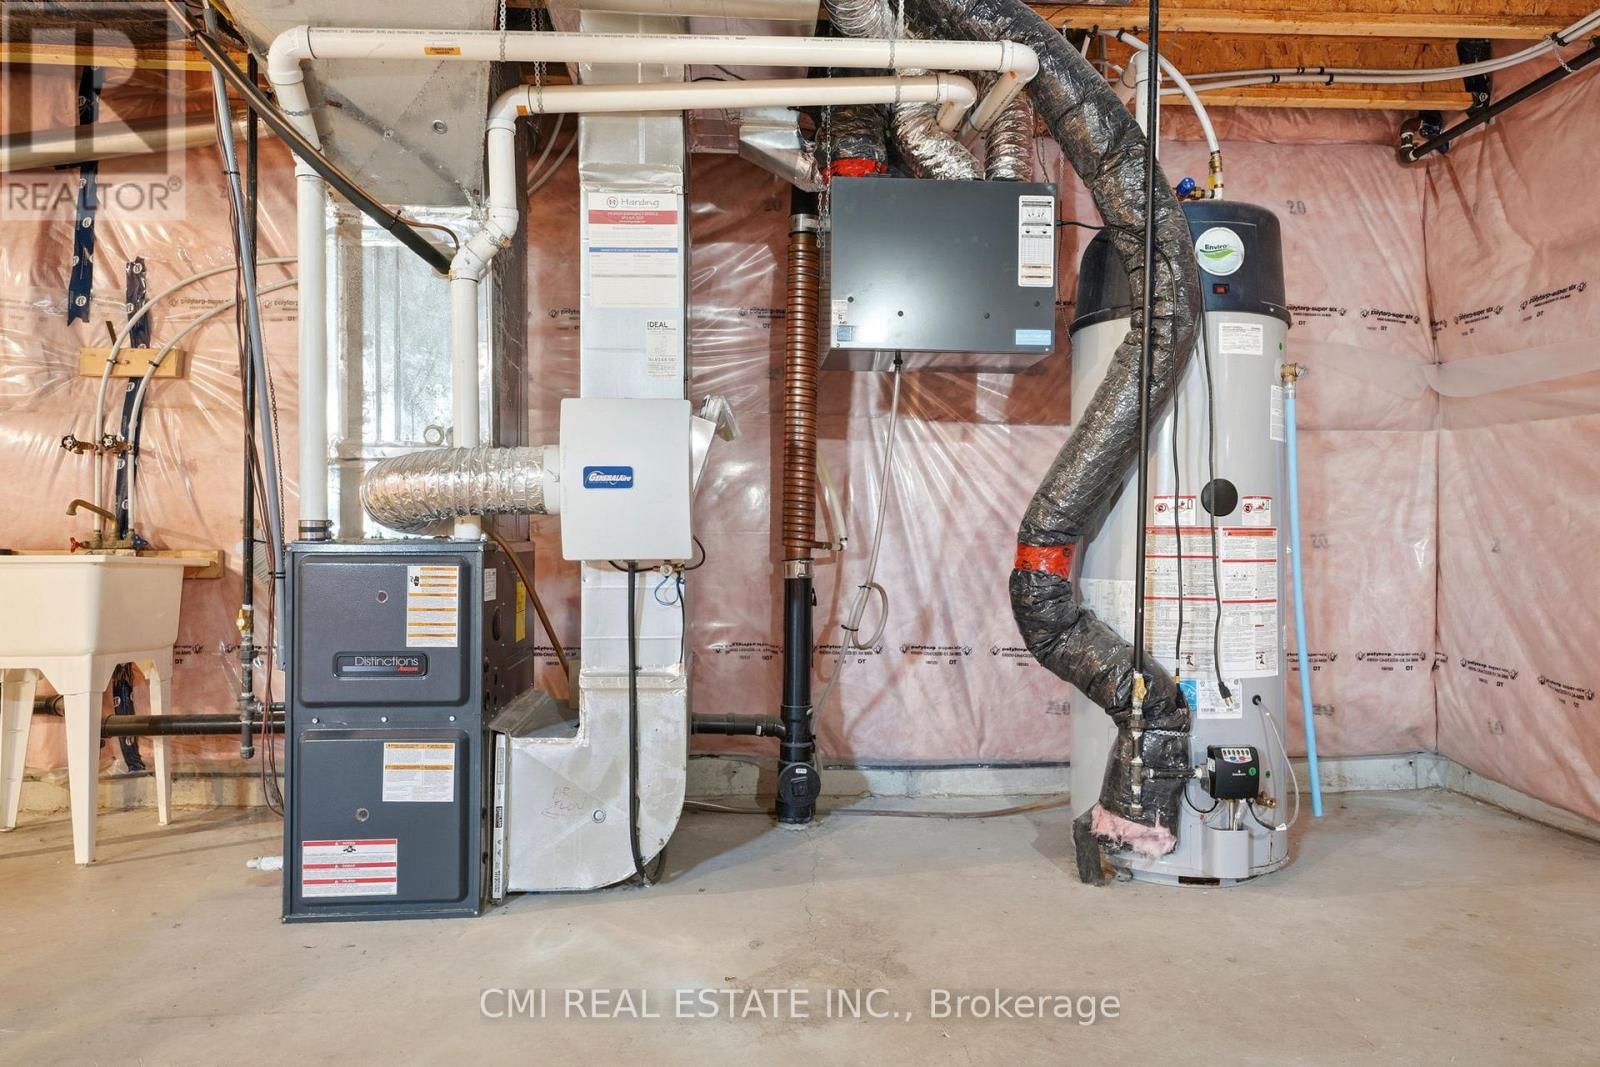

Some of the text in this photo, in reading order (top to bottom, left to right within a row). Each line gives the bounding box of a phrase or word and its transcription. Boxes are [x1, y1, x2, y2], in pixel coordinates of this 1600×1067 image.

[621, 198, 660, 208] Harding
[646, 320, 669, 328] IDEAL
[354, 656, 419, 666] Distinctions
